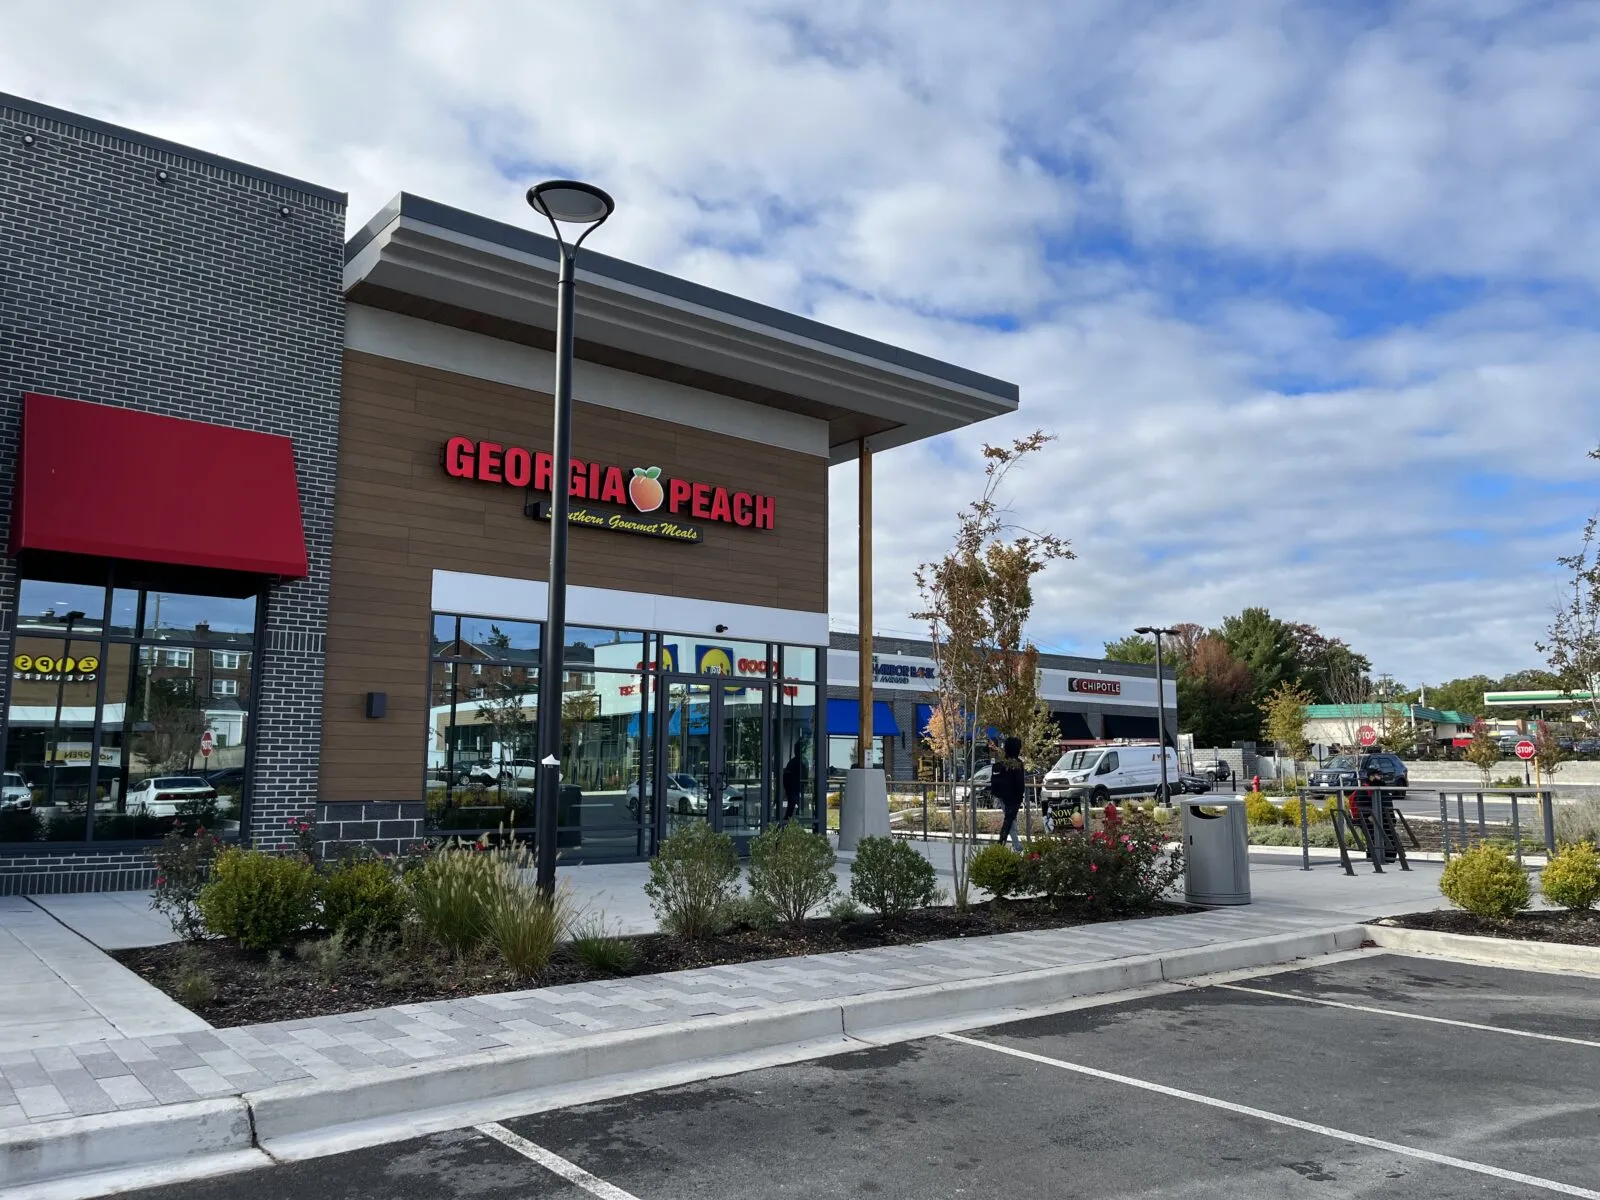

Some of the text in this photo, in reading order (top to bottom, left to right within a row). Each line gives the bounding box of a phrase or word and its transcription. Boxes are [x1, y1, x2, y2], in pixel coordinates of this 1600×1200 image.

[445, 436, 775, 530] GEORGIA PEACH
[545, 506, 698, 539] uthern Gourmet Meals
[1081, 681, 1120, 693] CHIPOTLE
[1517, 746, 1533, 754] STOP
[1051, 809, 1073, 818] NOW
